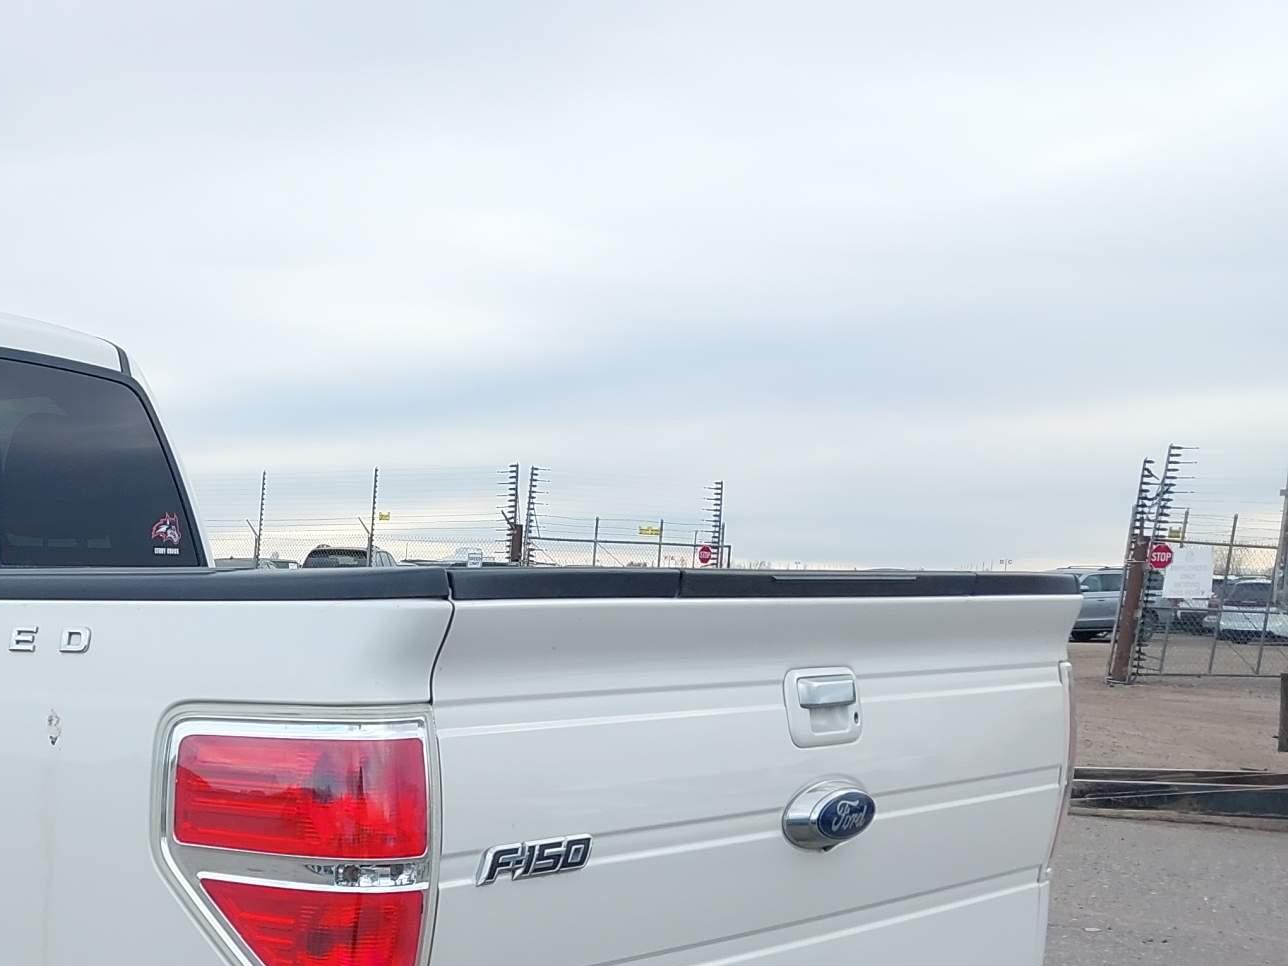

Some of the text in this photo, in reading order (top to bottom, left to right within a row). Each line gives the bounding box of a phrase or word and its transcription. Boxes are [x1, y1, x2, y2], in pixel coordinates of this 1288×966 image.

[699, 550, 712, 559] STOP
[1151, 551, 1172, 562] STOP
[831, 799, 868, 833] Ford
[477, 834, 593, 886] F-150
